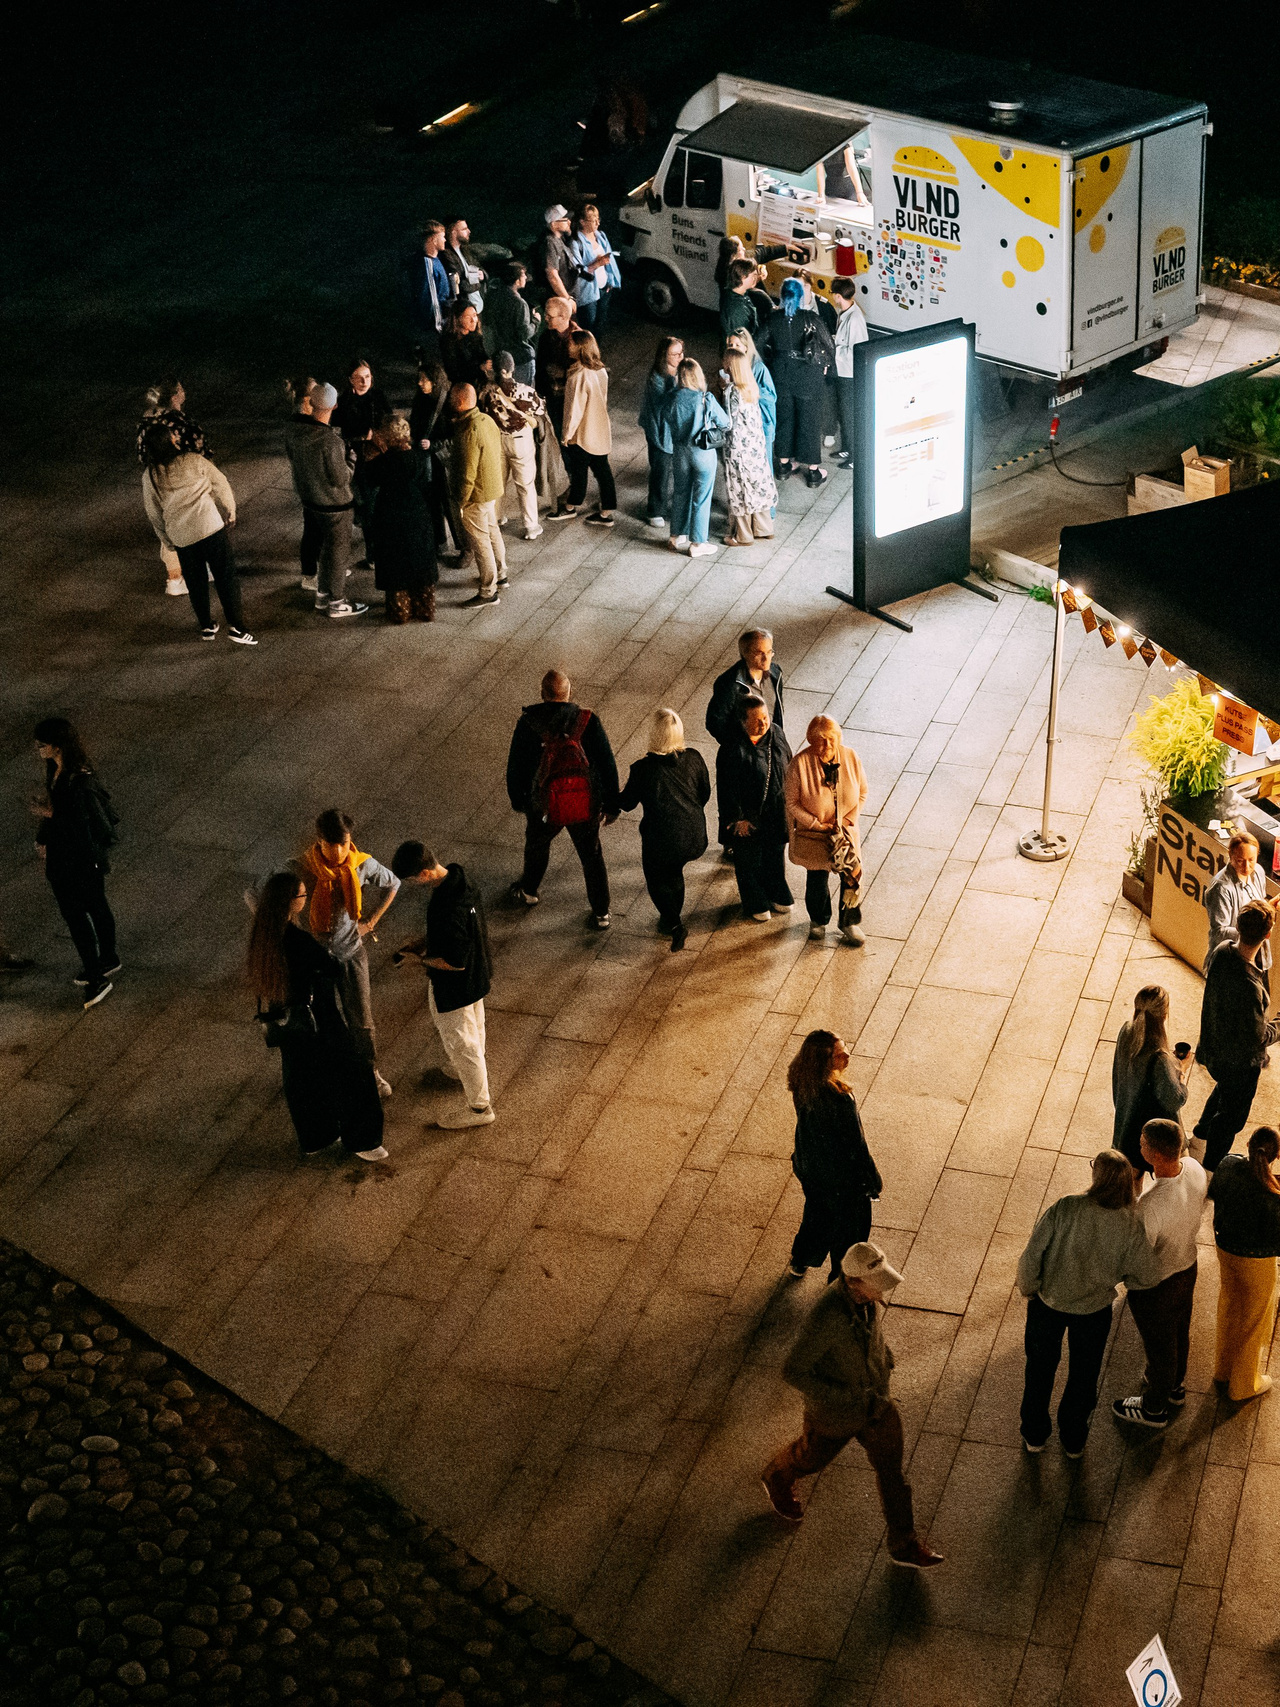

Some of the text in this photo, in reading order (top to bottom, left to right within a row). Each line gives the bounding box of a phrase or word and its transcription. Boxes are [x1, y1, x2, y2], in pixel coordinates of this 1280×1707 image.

[893, 175, 960, 219] VLND
[672, 213, 694, 229] Buns
[896, 208, 961, 242] BURGER
[672, 228, 707, 247] Friends
[1153, 246, 1186, 277] VLND
[1152, 268, 1185, 293] BURGER
[1216, 713, 1234, 727] PLUS
[1234, 721, 1253, 736] PASS
[1225, 705, 1247, 721] KUTSE
[1222, 727, 1245, 744] PRESS
